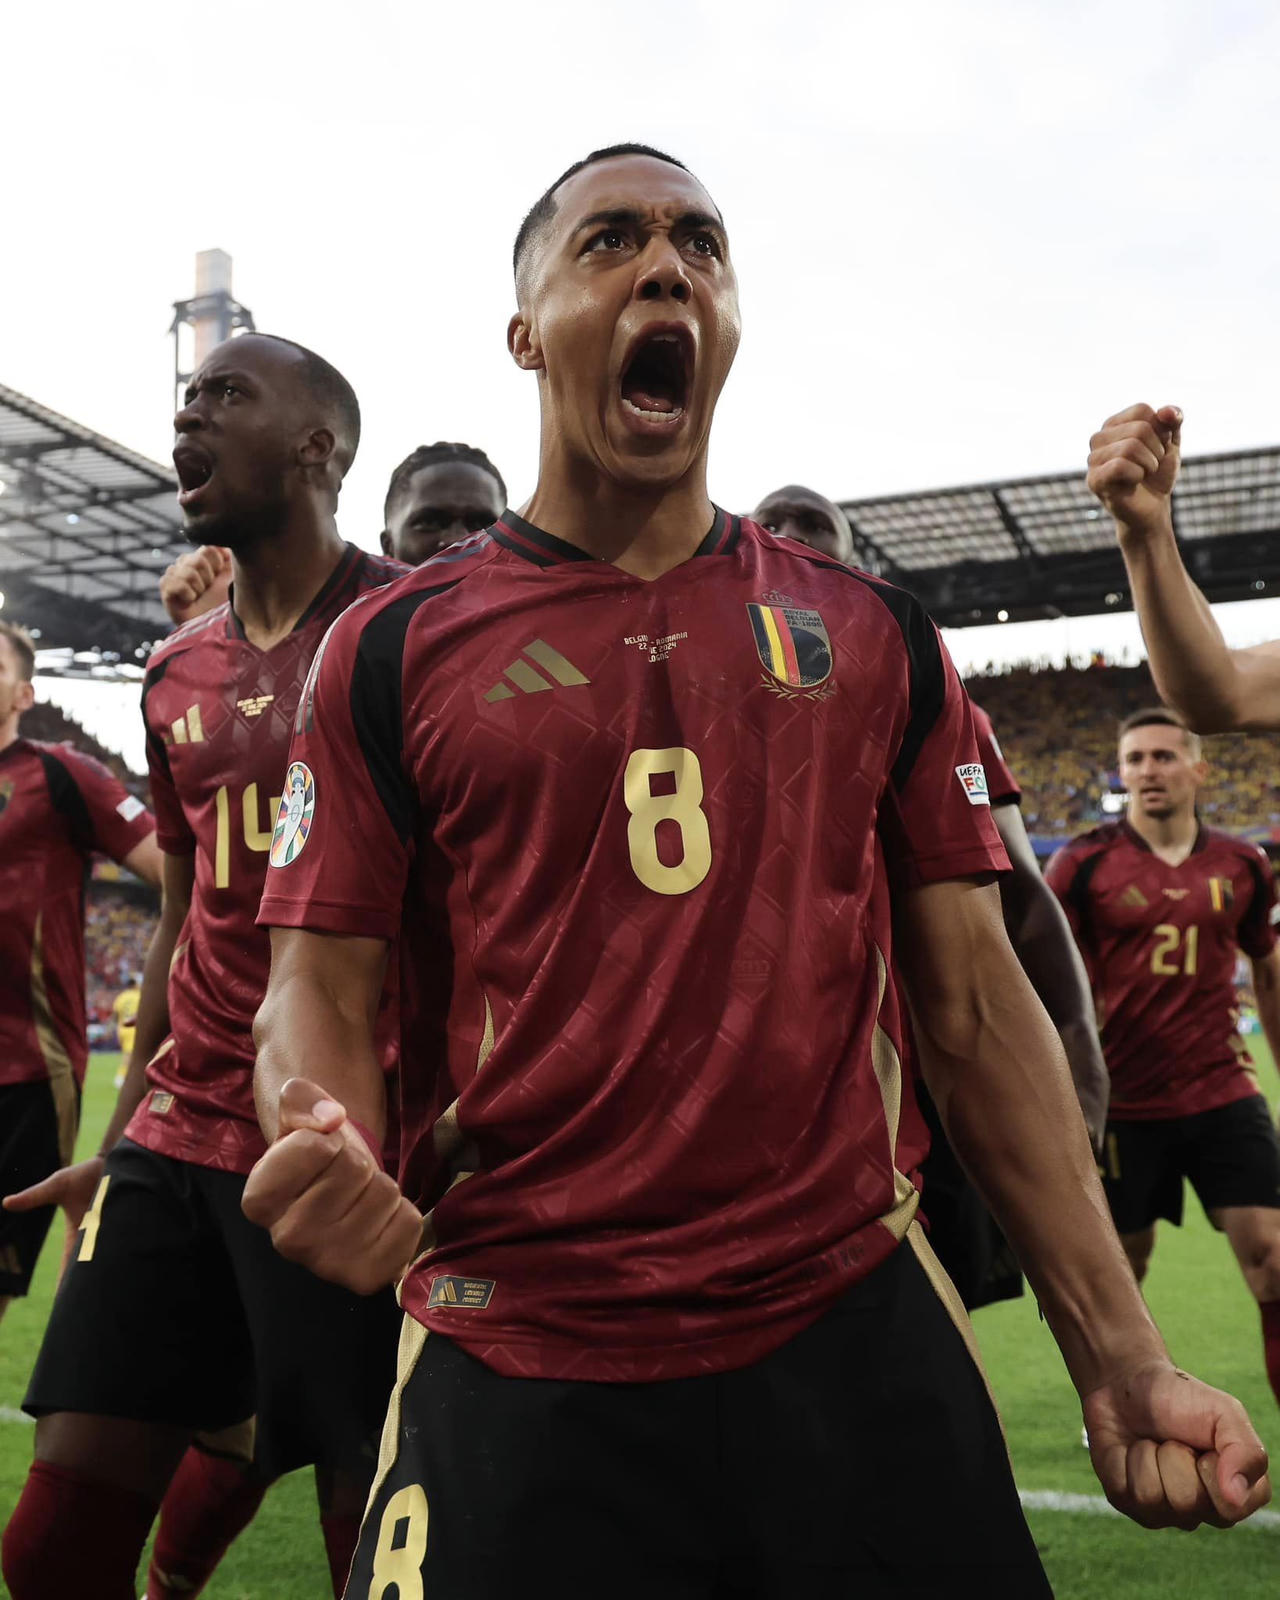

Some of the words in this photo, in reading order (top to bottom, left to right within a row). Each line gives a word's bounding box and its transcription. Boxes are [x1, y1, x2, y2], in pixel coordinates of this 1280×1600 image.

[623, 634, 649, 645] BELGIU
[648, 651, 670, 663] LOGNE
[215, 782, 282, 889] 14
[624, 747, 712, 895] 8
[1152, 923, 1199, 976] 21
[368, 1484, 429, 1600] 8
